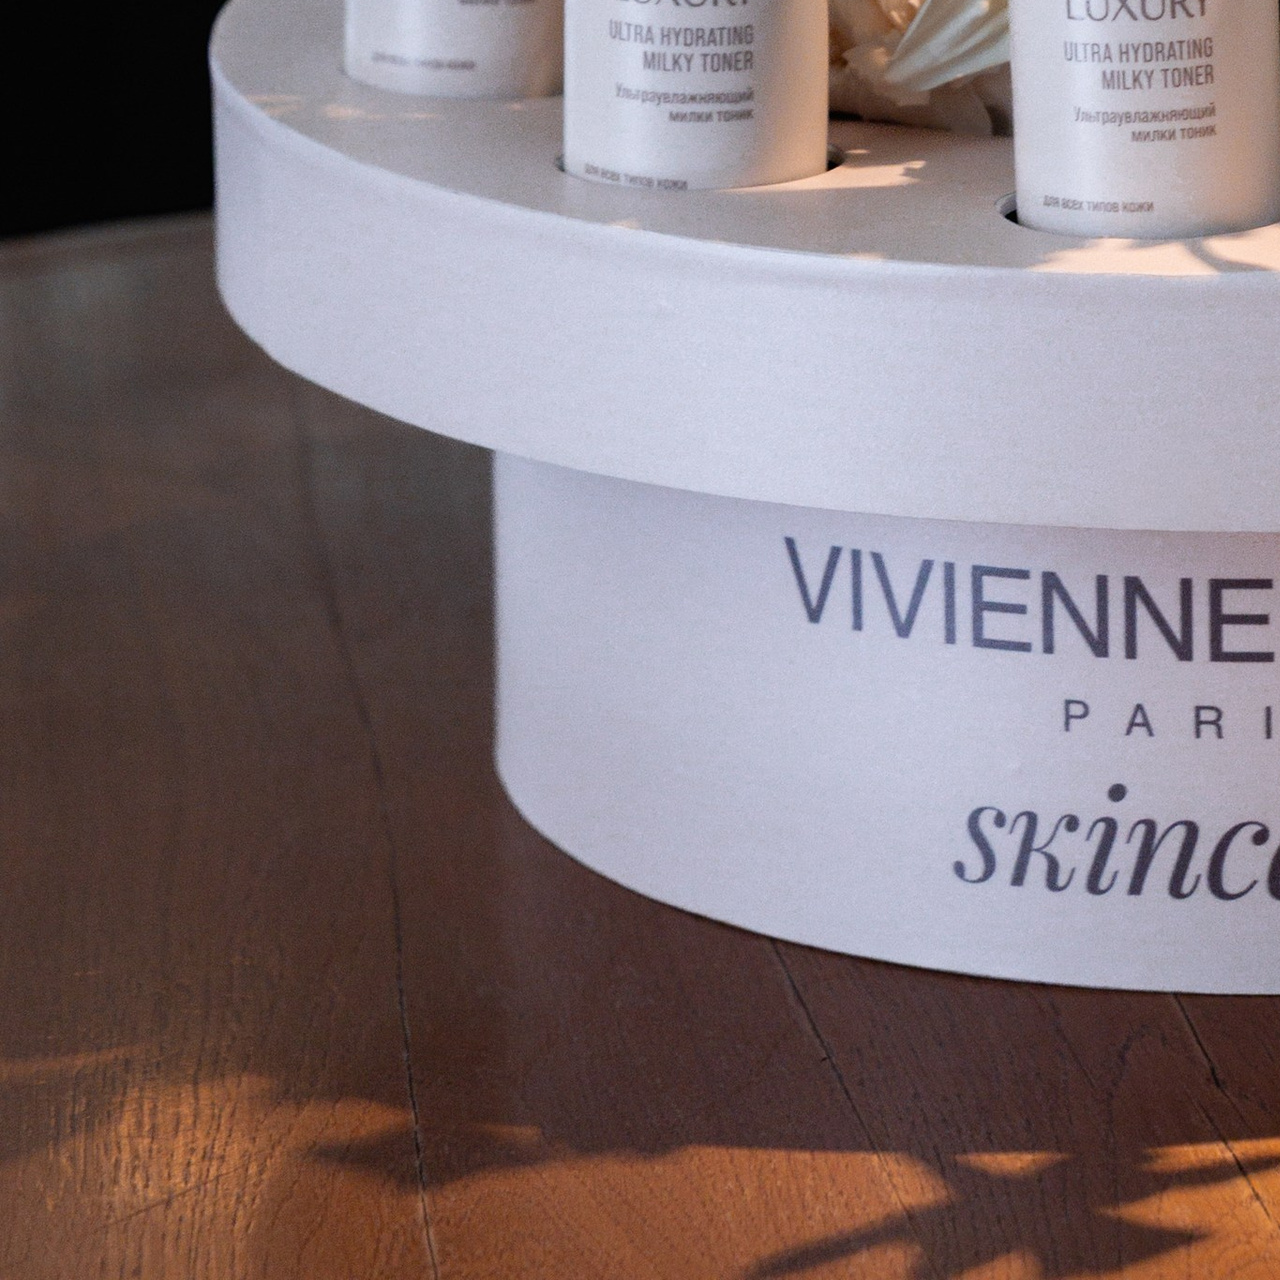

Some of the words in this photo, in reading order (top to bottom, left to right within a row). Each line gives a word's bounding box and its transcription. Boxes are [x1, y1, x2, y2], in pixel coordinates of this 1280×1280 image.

[609, 19, 655, 45] ULTRA
[660, 24, 755, 47] HYDRATING
[643, 50, 694, 73] MILKY
[702, 50, 755, 72] TONER
[1063, 40, 1113, 63] ULTRA
[1119, 37, 1214, 63] HYDRATING
[1101, 68, 1155, 91] MILKY
[1161, 64, 1215, 89] TONER
[783, 535, 1277, 664] VIVIENNE
